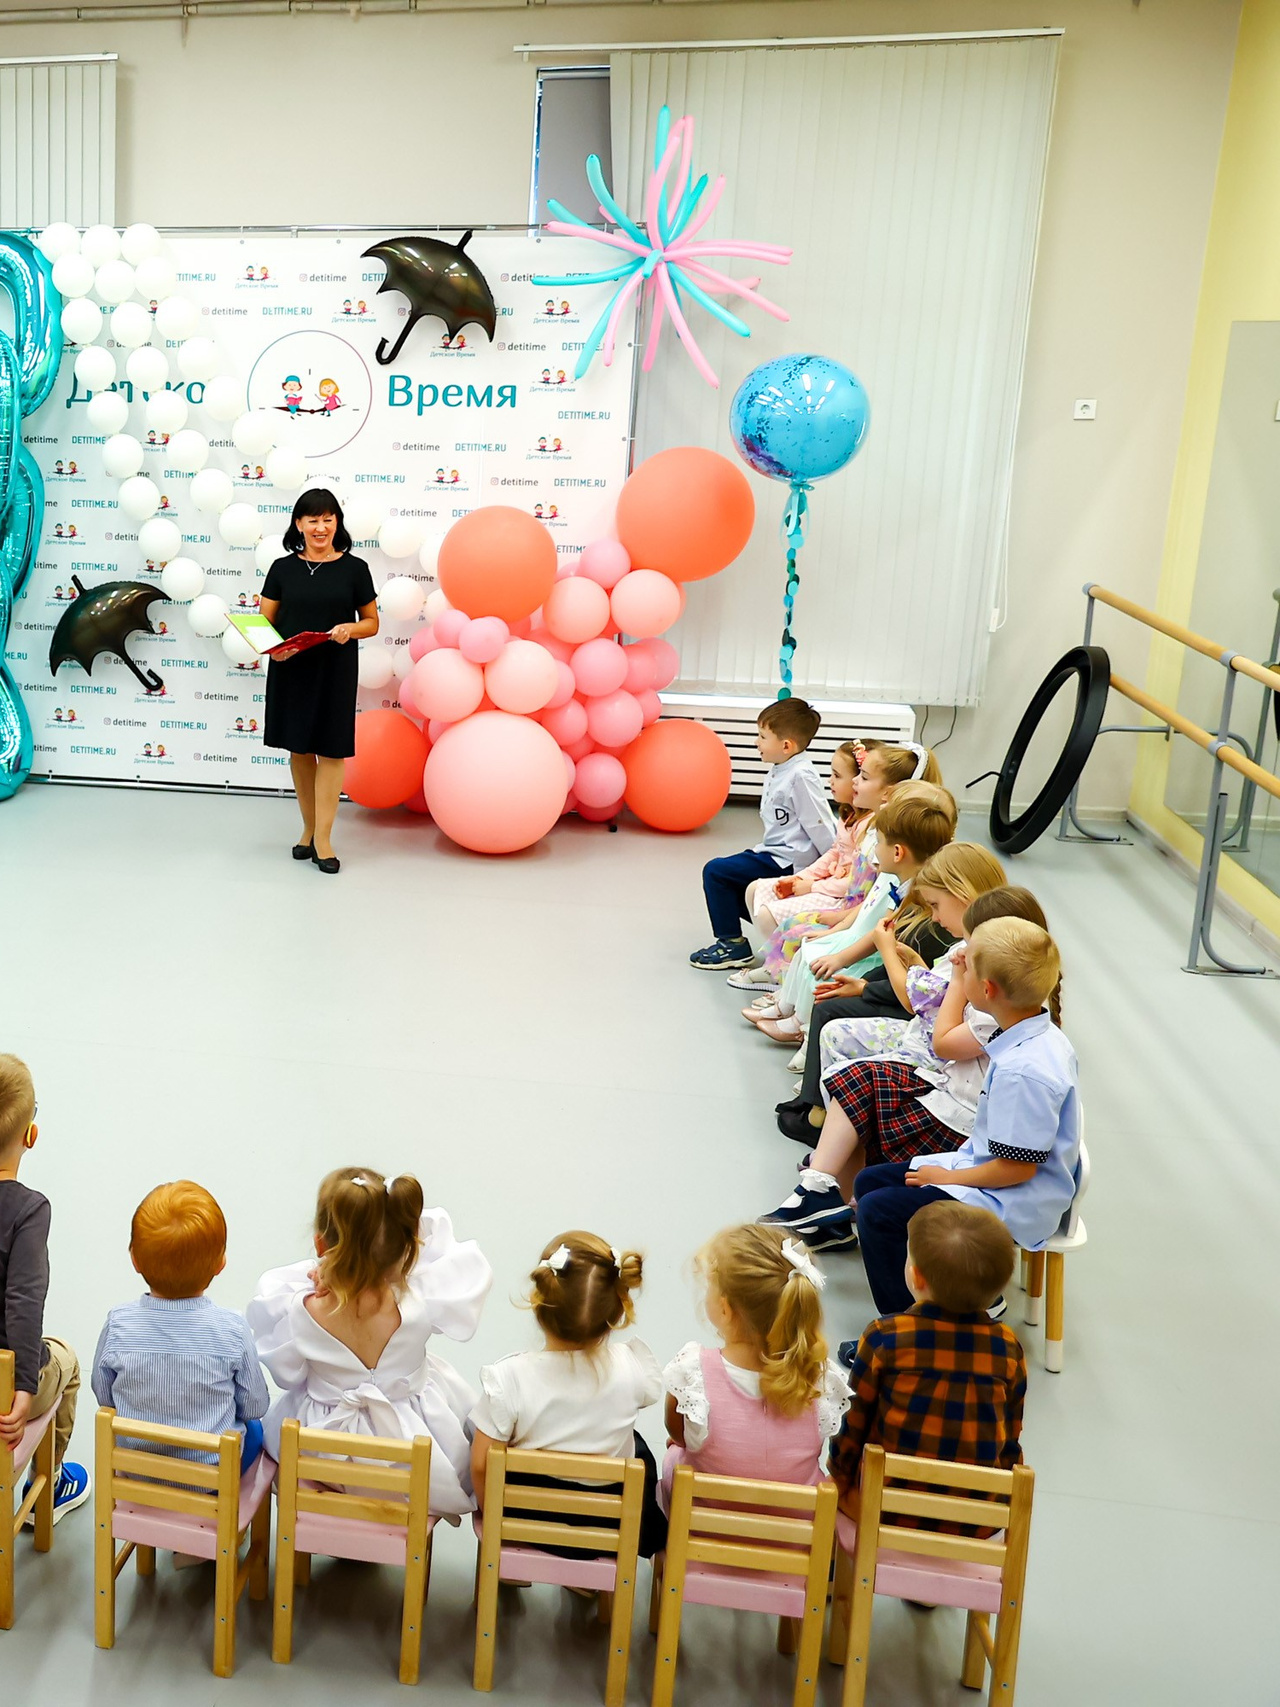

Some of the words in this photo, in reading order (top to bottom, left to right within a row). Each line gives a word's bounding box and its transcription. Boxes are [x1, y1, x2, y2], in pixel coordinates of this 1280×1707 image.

[177, 273, 216, 282] TITIME.RU
[310, 273, 347, 282] detitime
[211, 307, 248, 315] detitime
[262, 307, 313, 316] DETITIME.RU
[508, 342, 546, 351] detitime
[388, 374, 517, 416] Время
[558, 411, 611, 420] DETITIME.RU
[23, 436, 58, 444] detitime
[72, 436, 106, 444] DETITIME
[403, 442, 440, 451] detitime
[455, 443, 507, 452] DETITIME.RU
[355, 474, 405, 483] DETITIME.RU
[501, 478, 539, 486] detitime
[554, 479, 606, 487] DETITIME.RU
[71, 499, 119, 509] DETITIME.RU
[257, 504, 293, 514] DETITIME
[400, 509, 437, 517] detitime
[181, 534, 211, 543] TIME.RU
[34, 562, 58, 570] titime
[71, 562, 118, 571] DETITIME.RU
[206, 567, 242, 576] detitime
[161, 659, 209, 669] DETITIME.RU
[23, 683, 58, 692] detitime
[70, 685, 117, 695] DETITIME.RU
[203, 692, 239, 702] detitime
[112, 719, 147, 727] detitime
[160, 720, 208, 730] DETITIME.RU
[33, 745, 57, 753] titime
[70, 745, 117, 755] DETITIME.RU
[202, 754, 238, 763] detitime
[251, 755, 291, 766] DETITIME.
